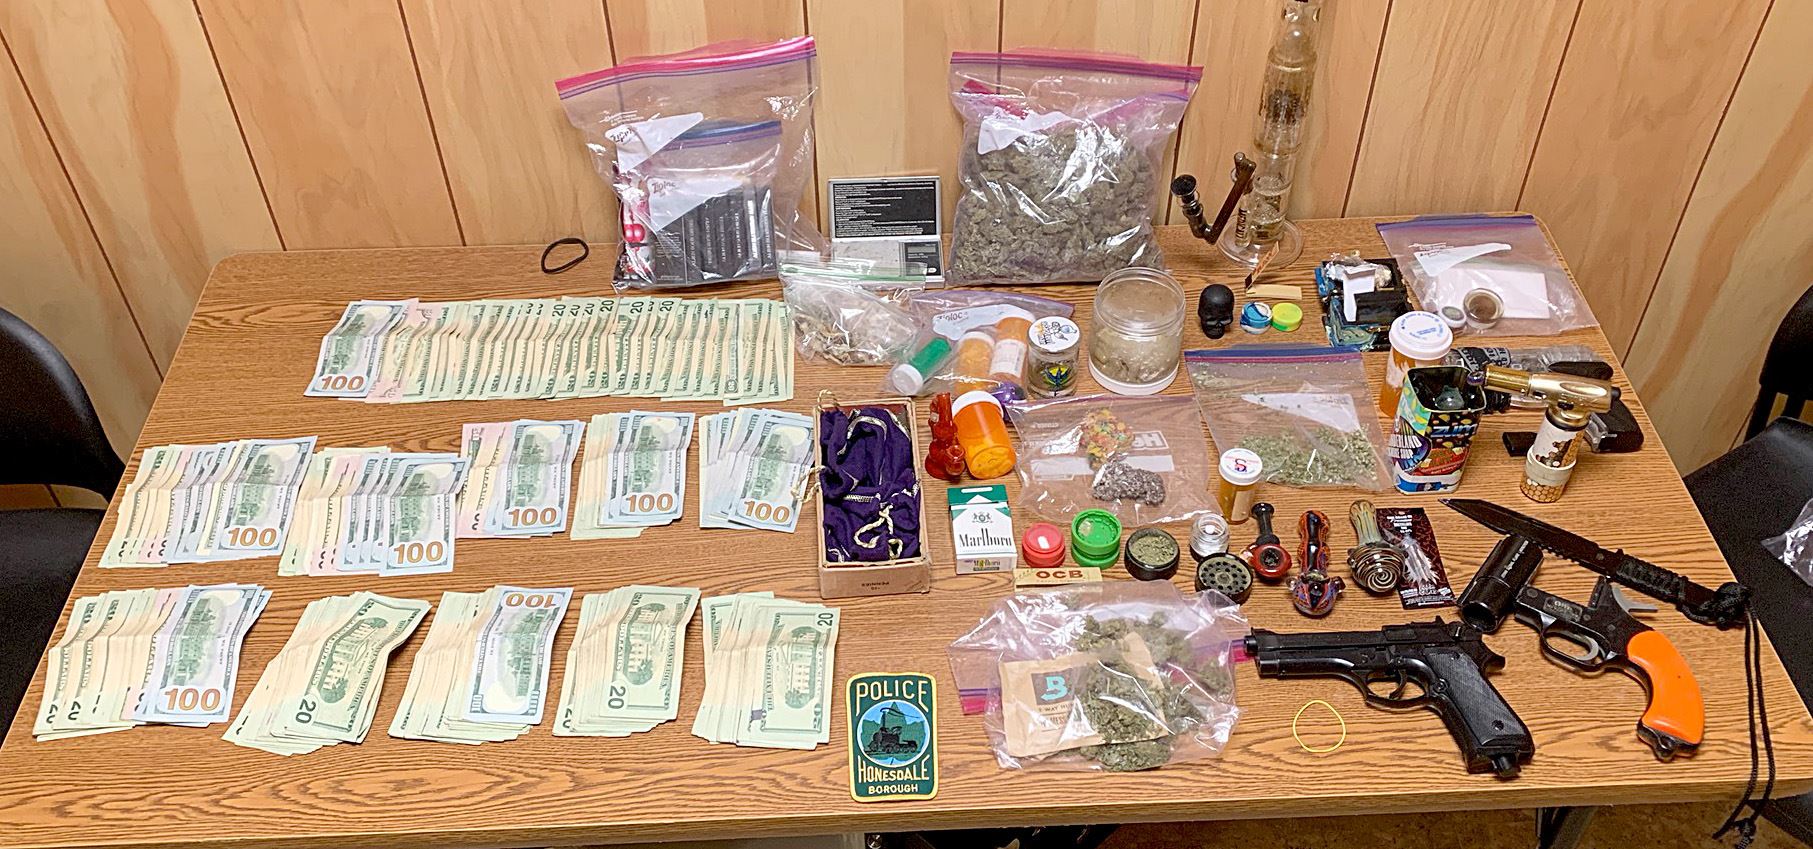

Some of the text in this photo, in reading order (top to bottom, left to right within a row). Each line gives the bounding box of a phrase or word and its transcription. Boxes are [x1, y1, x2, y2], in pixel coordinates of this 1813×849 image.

[552, 304, 566, 317] 20
[600, 300, 615, 312] 20
[630, 301, 644, 314] 20
[660, 300, 674, 312] 20
[321, 376, 364, 391] 100
[626, 493, 674, 514] 100
[744, 500, 790, 525] 100
[508, 508, 557, 527] 100
[228, 528, 278, 548] 100
[959, 528, 1012, 548] Marlboro
[394, 541, 445, 565] 100
[1036, 570, 1083, 579] OCB
[506, 593, 557, 608] 100
[818, 612, 834, 626] 20
[164, 688, 220, 712] 100
[608, 685, 626, 710] 20
[856, 680, 928, 716] POLICE
[295, 698, 316, 724] 20
[858, 754, 930, 783] HONESDALE
[868, 784, 918, 794] BOROUGH
